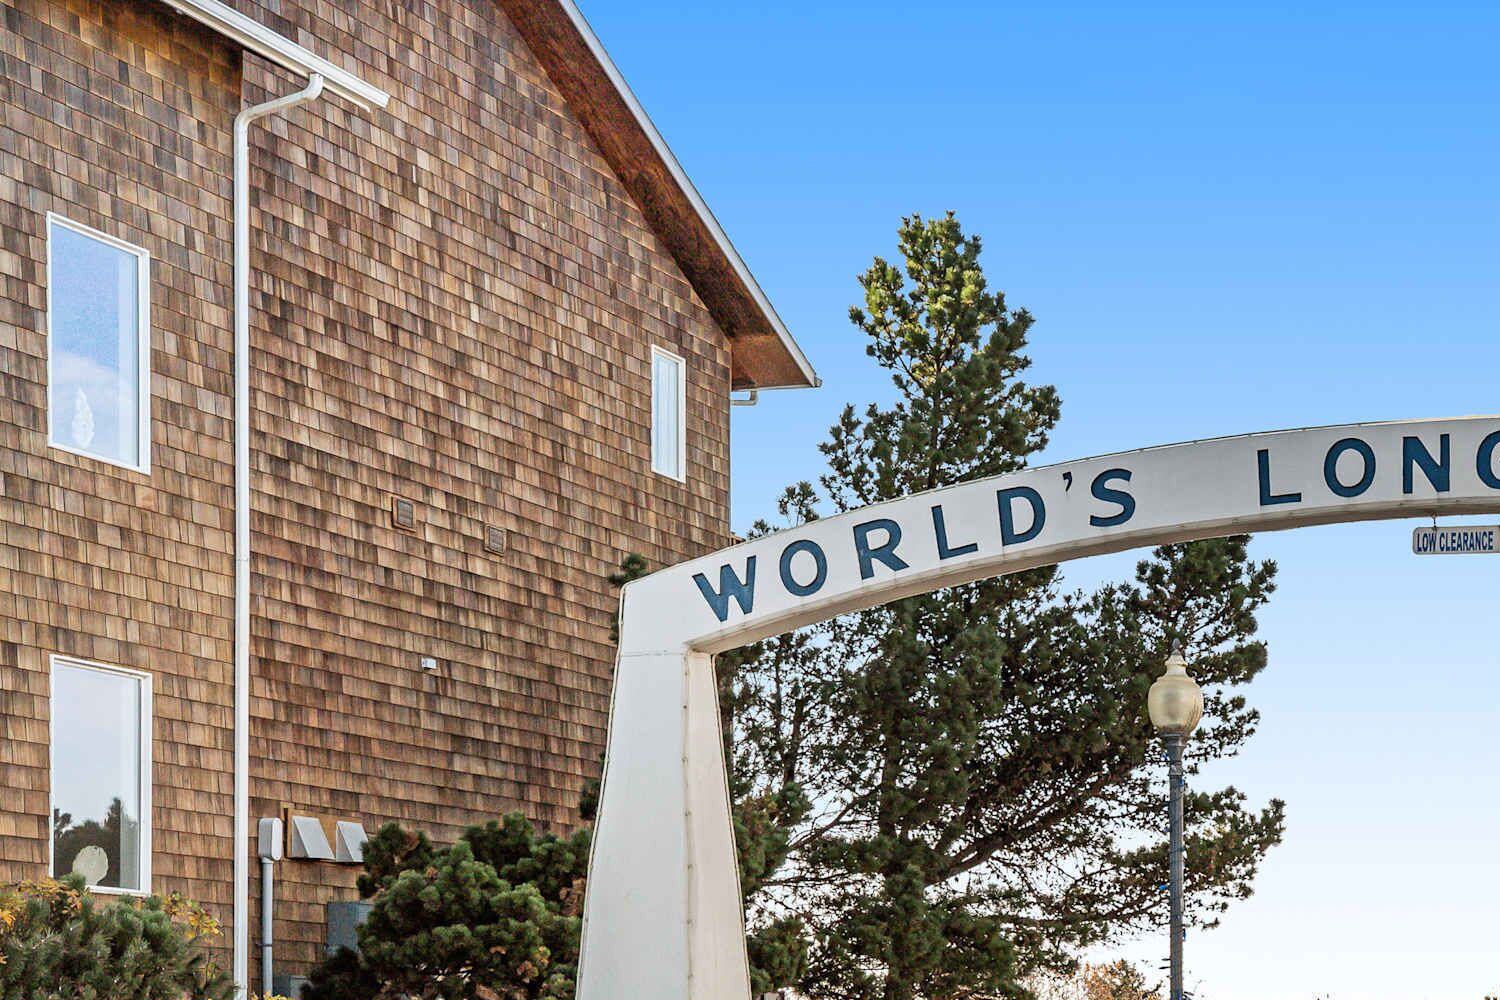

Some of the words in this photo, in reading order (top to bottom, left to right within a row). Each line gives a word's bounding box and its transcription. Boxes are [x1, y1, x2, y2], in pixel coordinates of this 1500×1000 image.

[692, 468, 1136, 623] WORLD'S
[1416, 532, 1437, 552] LOW
[1439, 531, 1494, 552] CLEARANCE
